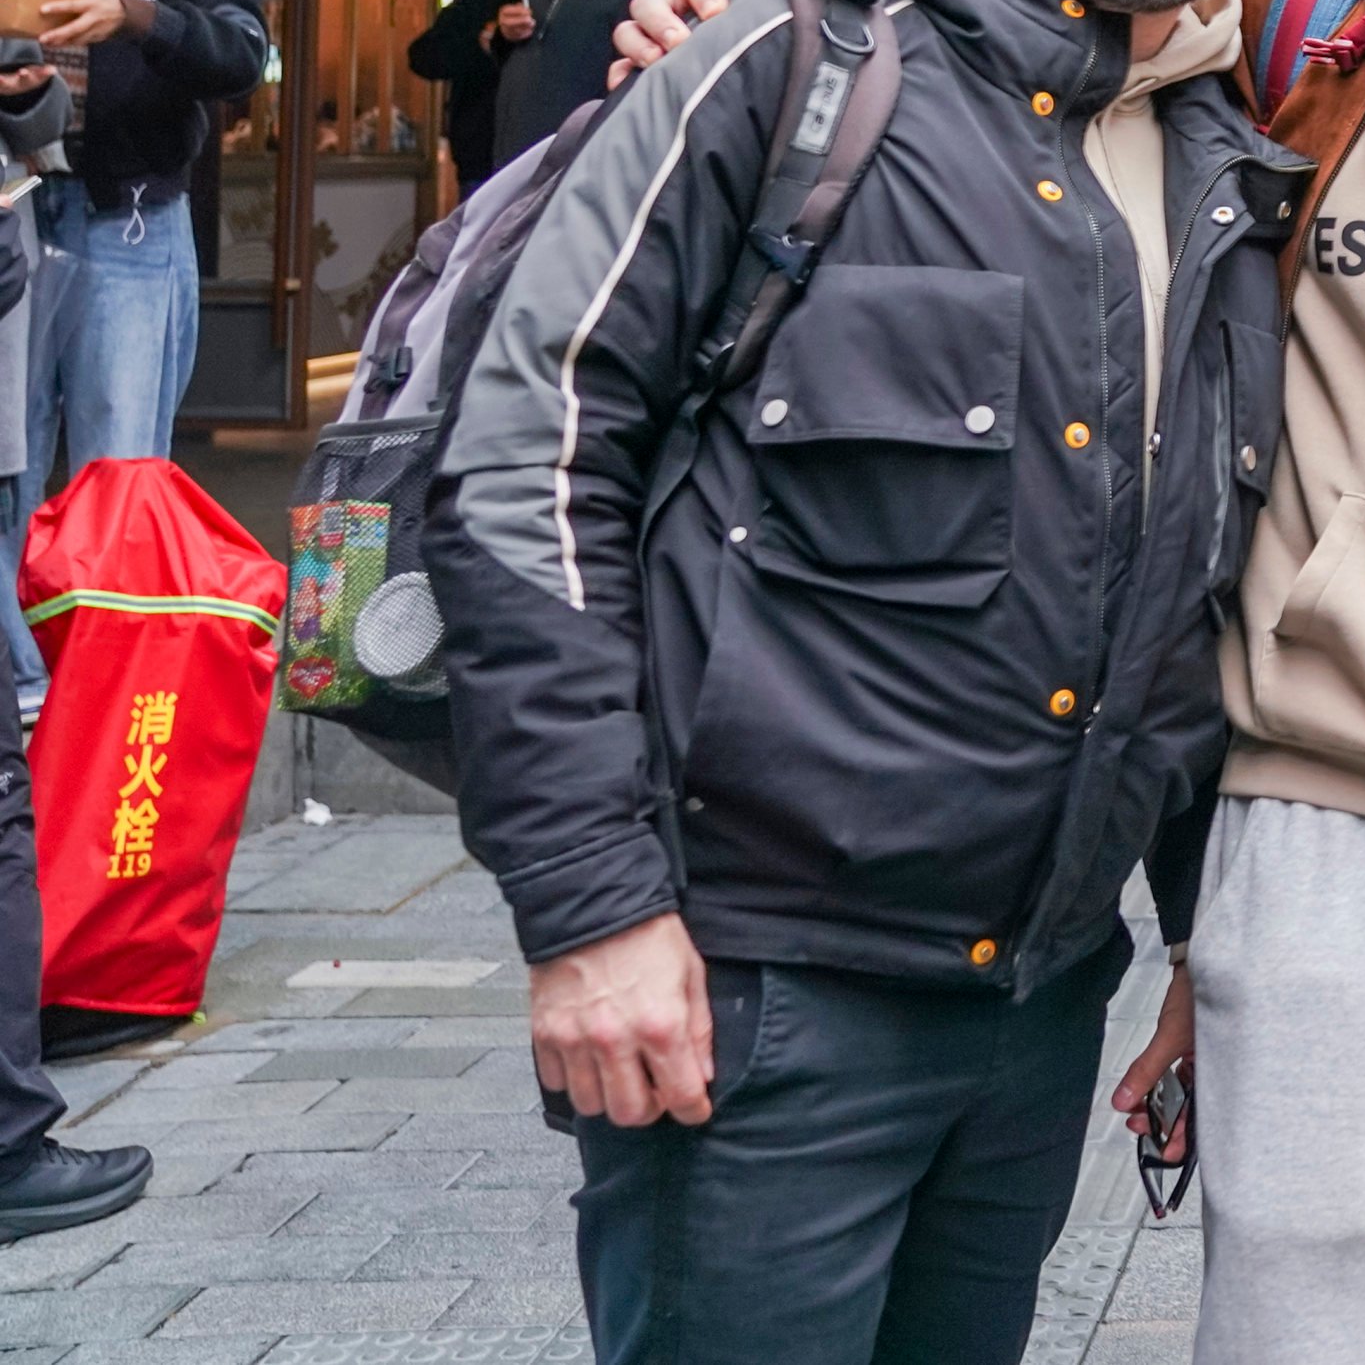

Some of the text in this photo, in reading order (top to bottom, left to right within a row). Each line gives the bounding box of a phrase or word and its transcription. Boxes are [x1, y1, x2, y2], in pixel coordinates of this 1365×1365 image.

[112, 690, 179, 855] 消火栓
[106, 852, 152, 879] 119
